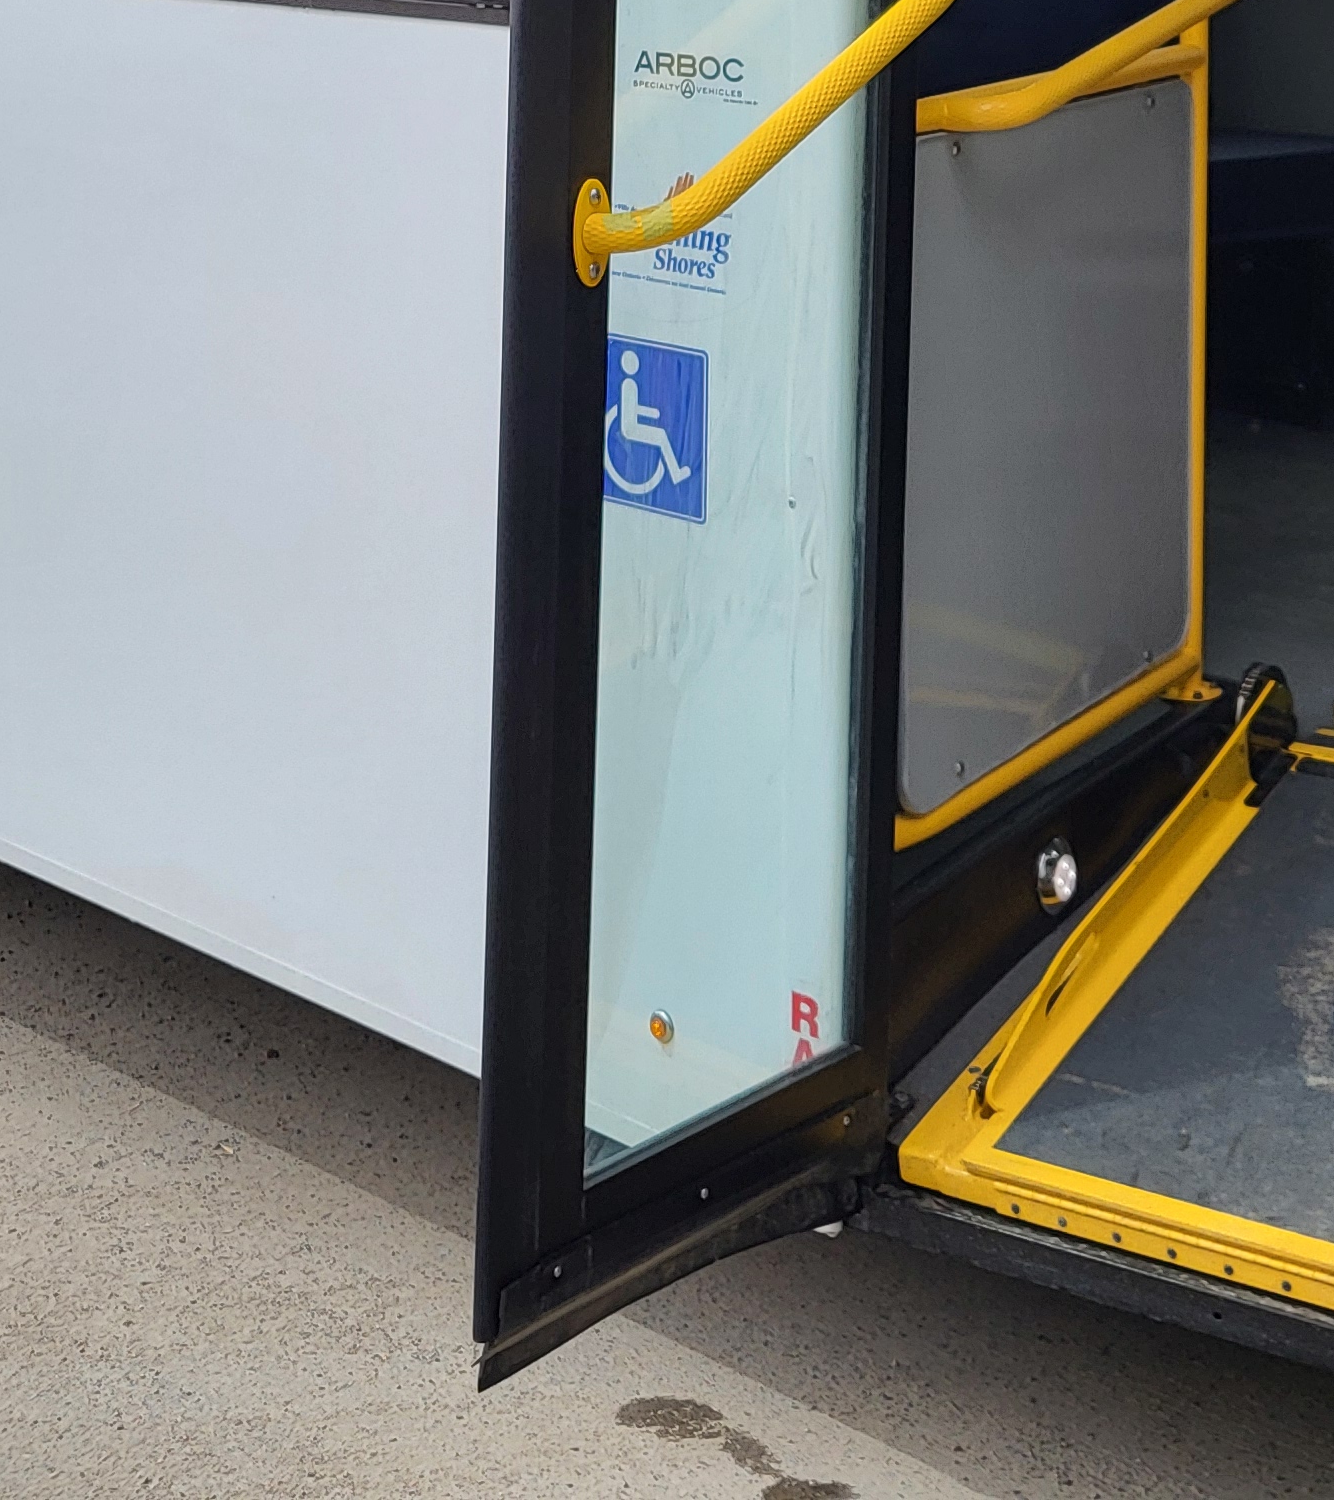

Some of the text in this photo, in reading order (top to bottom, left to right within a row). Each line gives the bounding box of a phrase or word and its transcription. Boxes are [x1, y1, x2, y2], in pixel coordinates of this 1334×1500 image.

[633, 50, 745, 83] ARBOC
[632, 79, 680, 92] SPECIALTY
[696, 86, 743, 98] VEHICLES
[653, 247, 716, 279] Shores
